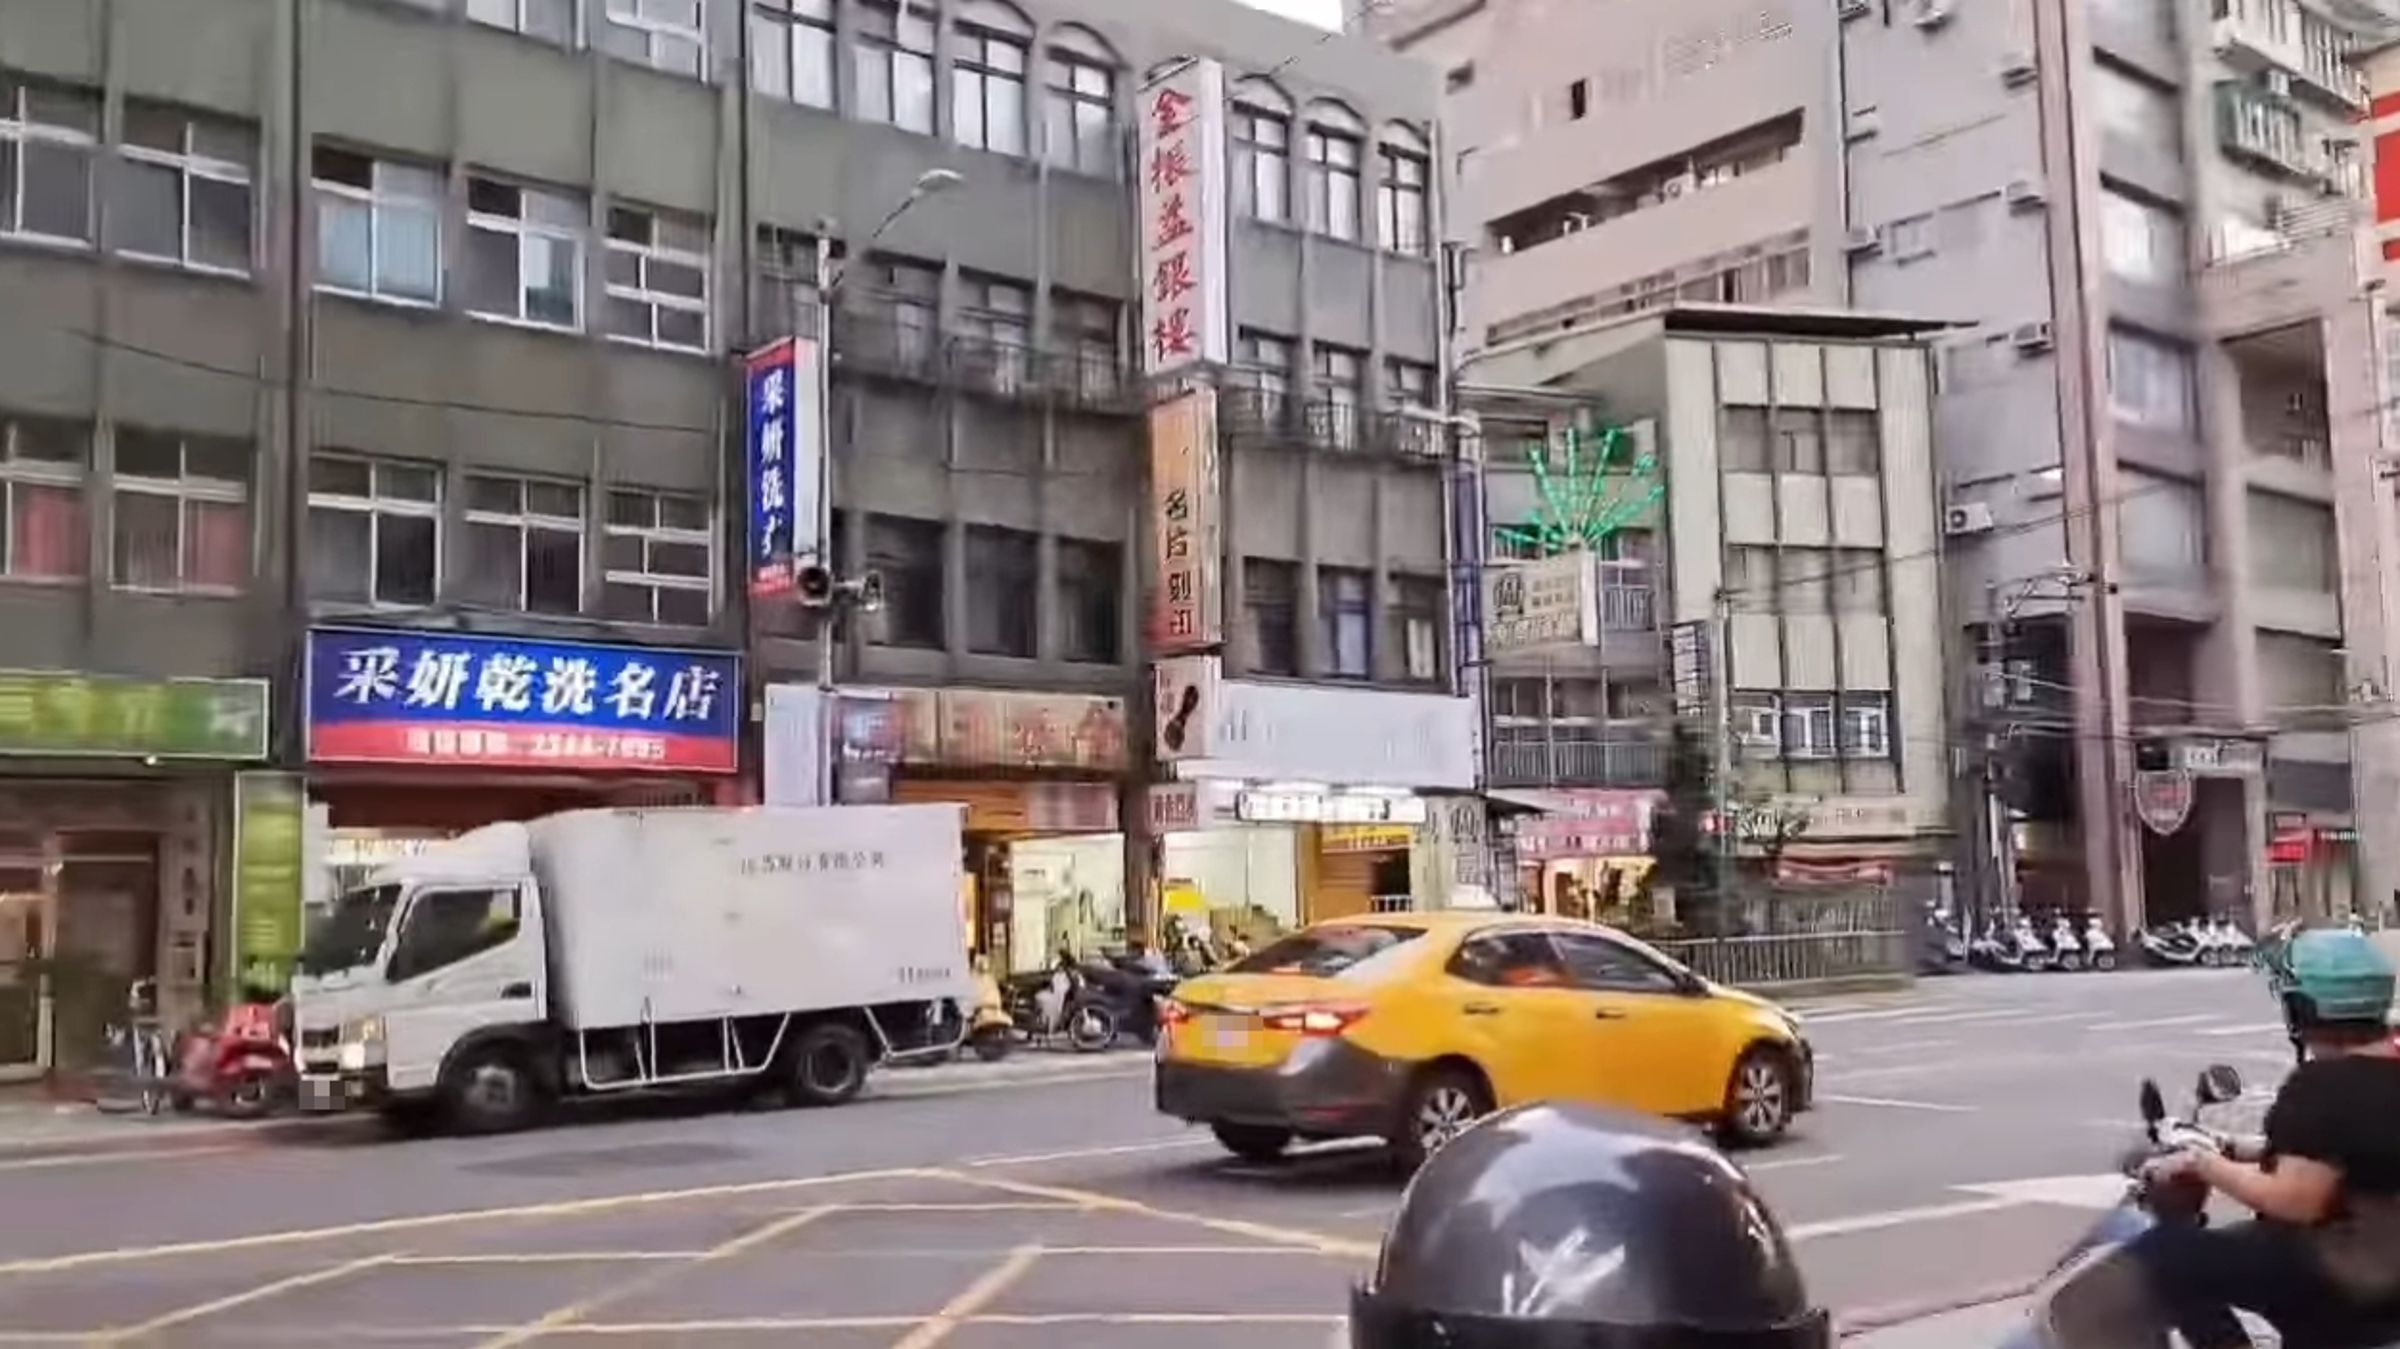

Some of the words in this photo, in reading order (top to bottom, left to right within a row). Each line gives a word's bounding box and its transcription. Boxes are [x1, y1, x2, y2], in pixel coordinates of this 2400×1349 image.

[332, 645, 721, 721] 采妍乾洗名店
